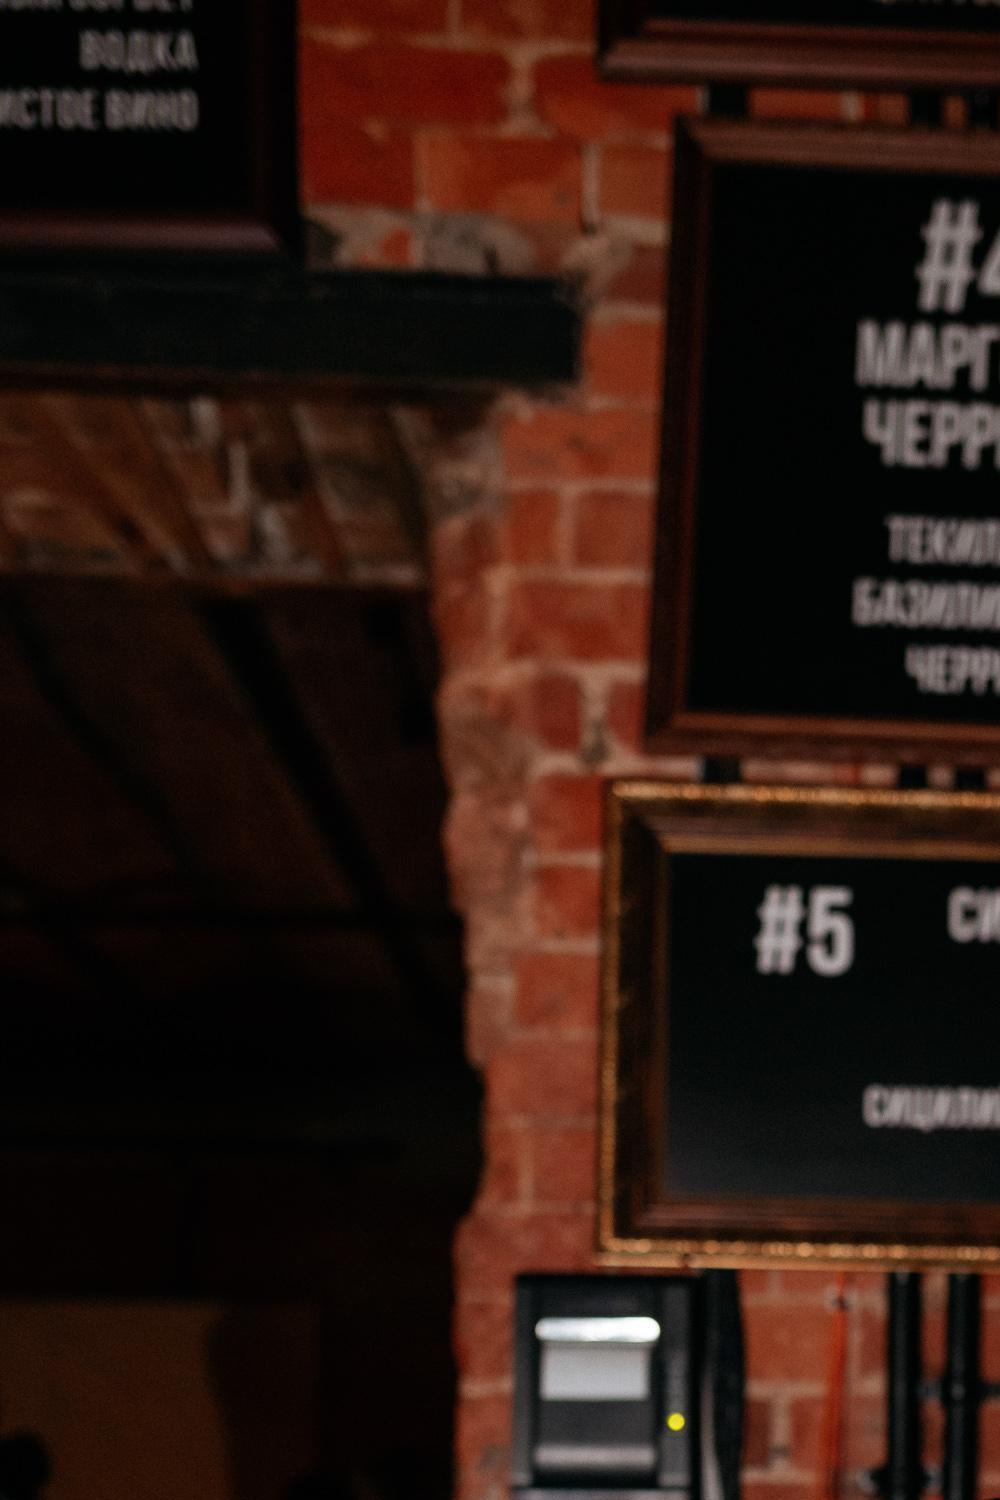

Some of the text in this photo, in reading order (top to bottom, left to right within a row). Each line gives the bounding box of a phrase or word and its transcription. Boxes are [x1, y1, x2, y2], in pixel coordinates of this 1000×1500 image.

[79, 29, 199, 74] ВОДКА
[104, 89, 199, 131] ВИНО
[753, 884, 856, 977] #5
